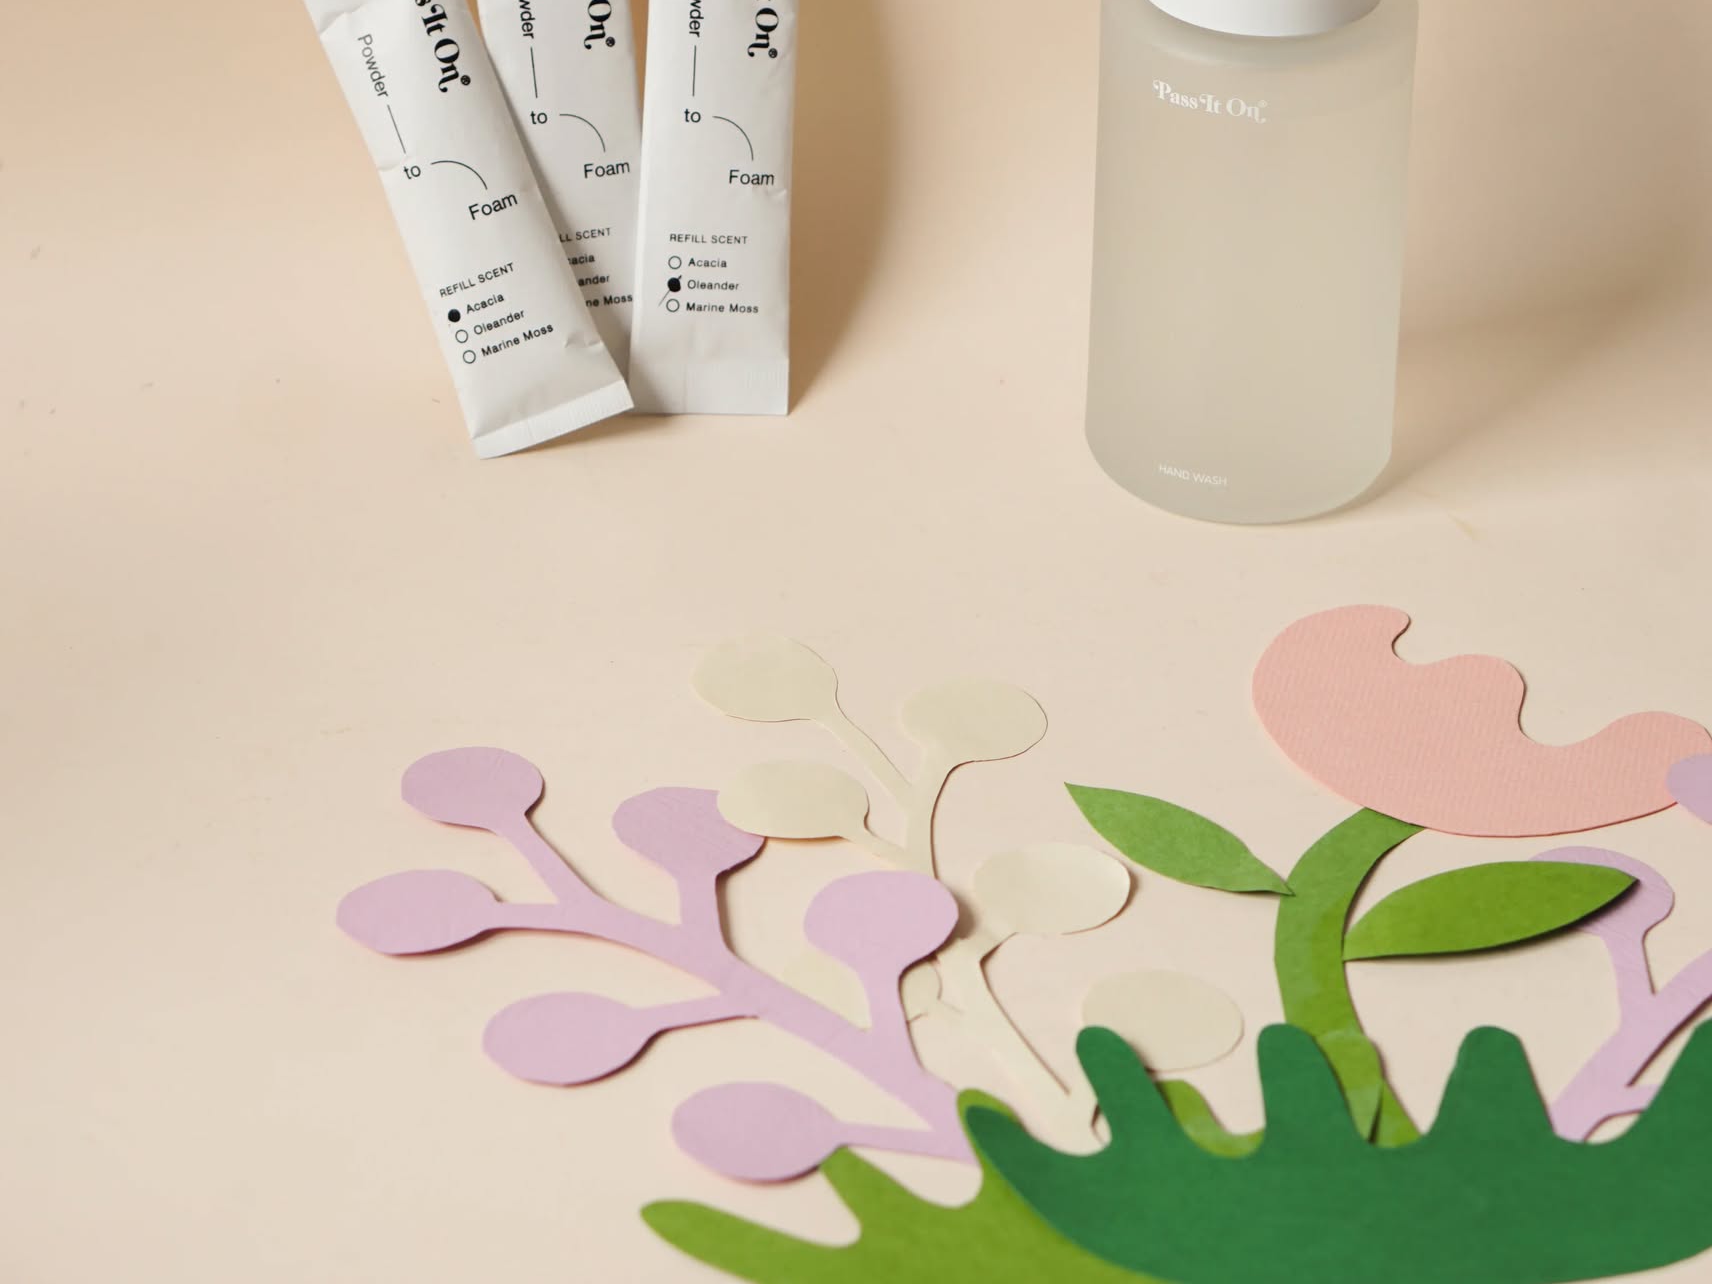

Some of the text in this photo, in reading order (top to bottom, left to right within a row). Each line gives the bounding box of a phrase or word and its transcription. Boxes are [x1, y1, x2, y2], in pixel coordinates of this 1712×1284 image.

[421, 4, 448, 36] It
[358, 34, 389, 97] Powder
[1152, 79, 1198, 109] Pass
[1199, 94, 1222, 114] It
[530, 110, 547, 125] to
[684, 108, 701, 123] to
[403, 165, 421, 180] to
[584, 161, 630, 178] Foam
[729, 169, 775, 186] Foam
[469, 192, 518, 220] Foam
[576, 228, 611, 241] SCENT
[669, 233, 748, 245] REFILL SCENT
[567, 254, 595, 265] acia
[688, 257, 727, 268] Acacia
[439, 262, 514, 297] REFILL SCENT
[577, 275, 610, 287] ander
[687, 279, 740, 290] Oleander
[466, 294, 505, 314] Acacia
[603, 294, 633, 306] Moss
[686, 302, 759, 314] Marine Moss
[473, 309, 525, 335] Oleander
[481, 324, 554, 357] Marine Moss
[1159, 463, 1228, 487] HAND WASH
